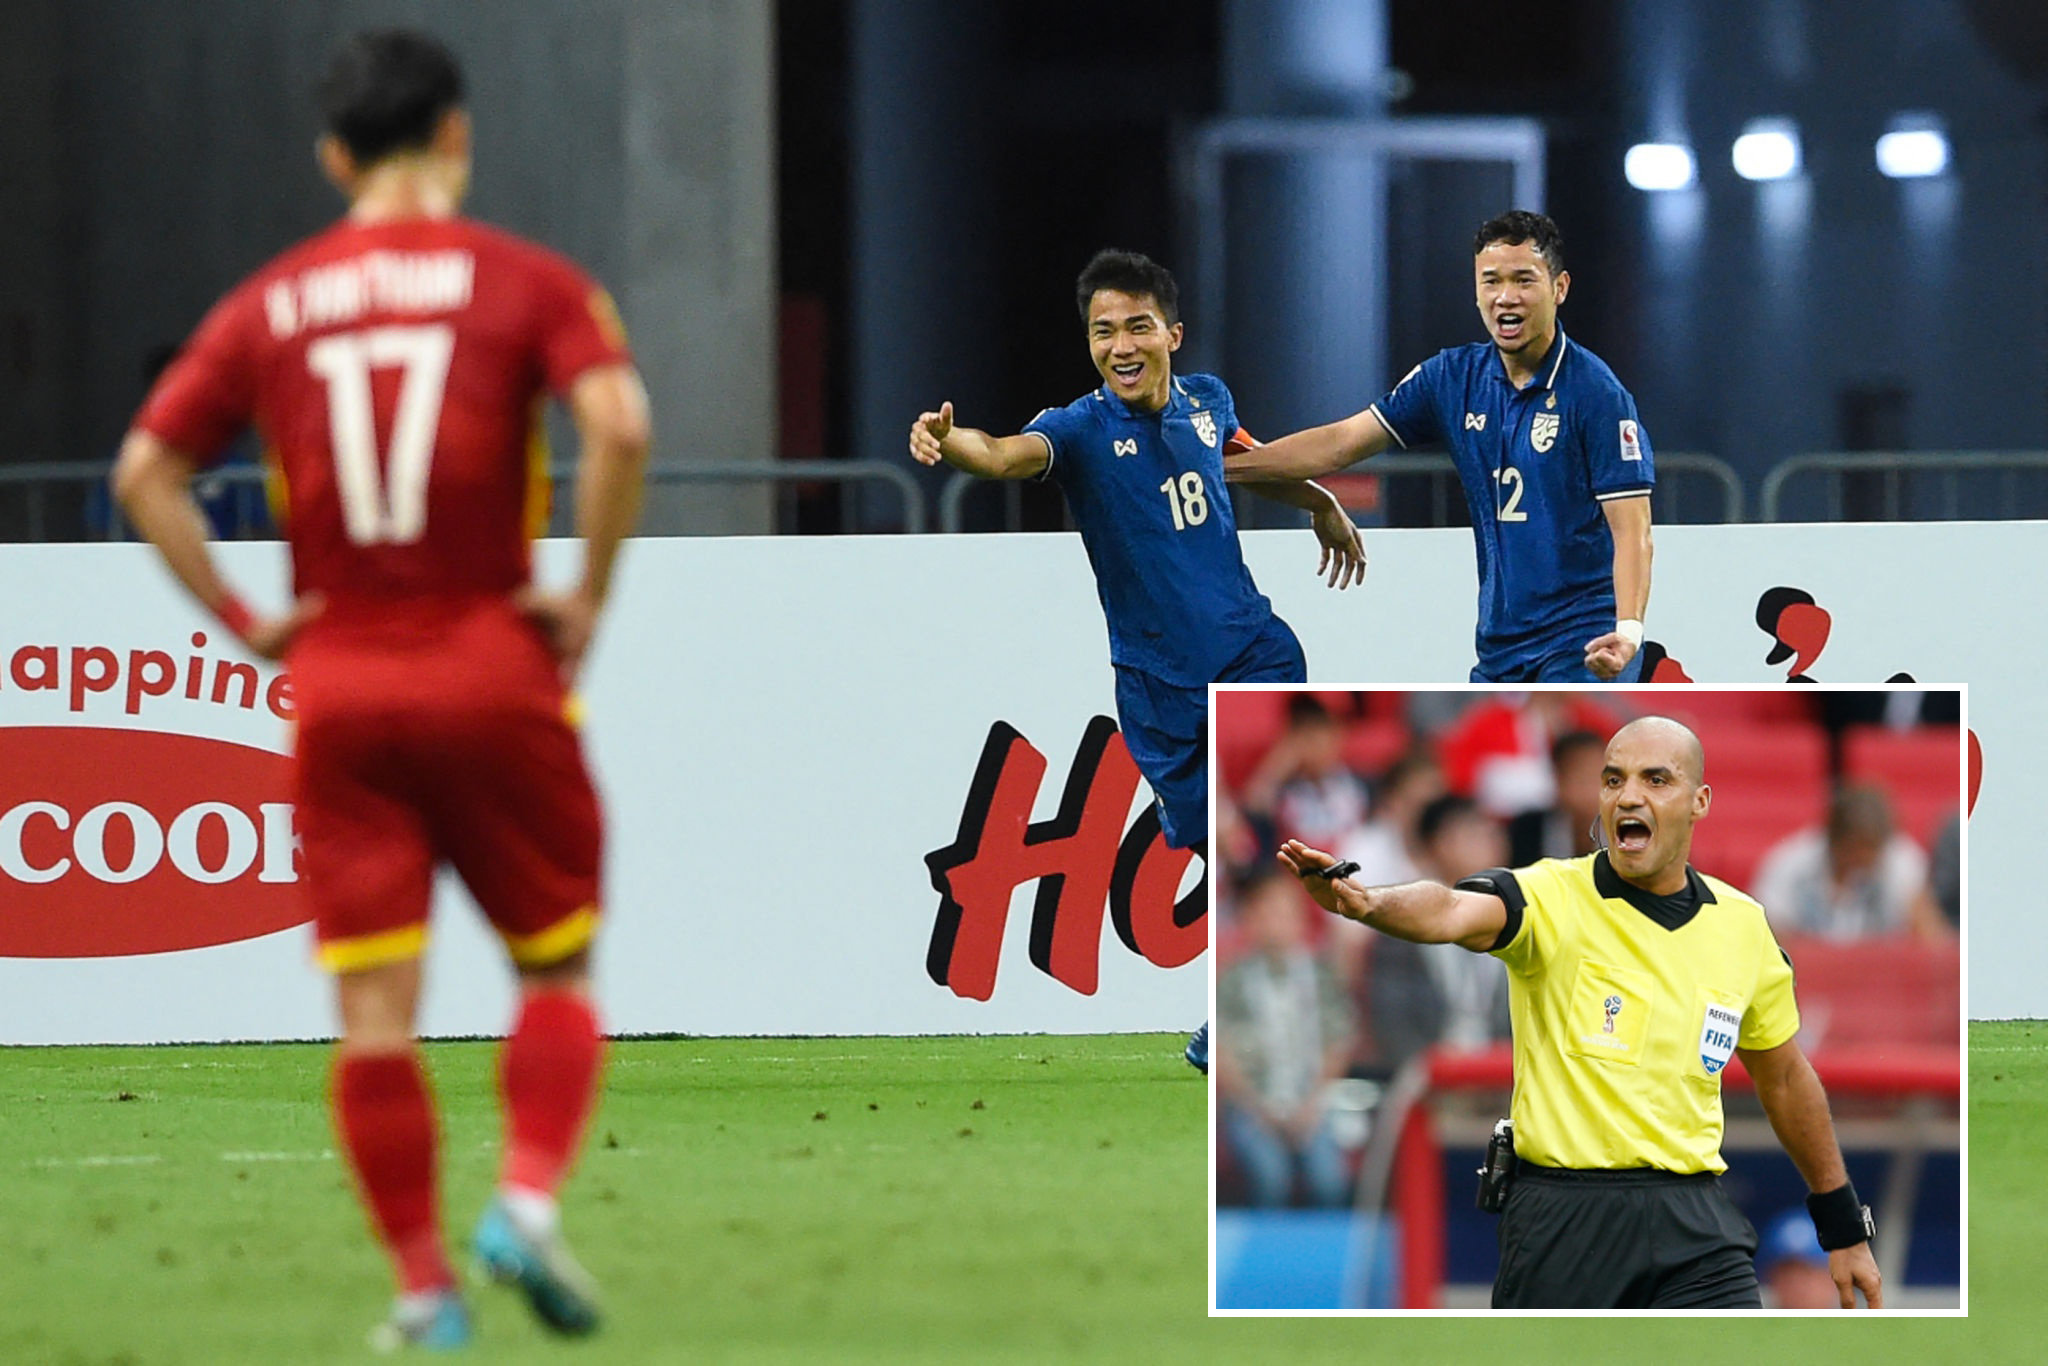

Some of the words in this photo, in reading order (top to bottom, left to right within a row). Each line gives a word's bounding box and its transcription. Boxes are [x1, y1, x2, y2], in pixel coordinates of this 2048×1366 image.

[306, 323, 455, 545] 17
[1160, 471, 1208, 531] 18
[1492, 466, 1527, 522] 12
[0, 631, 298, 721] appine
[1705, 1028, 1732, 1051] FIFA
